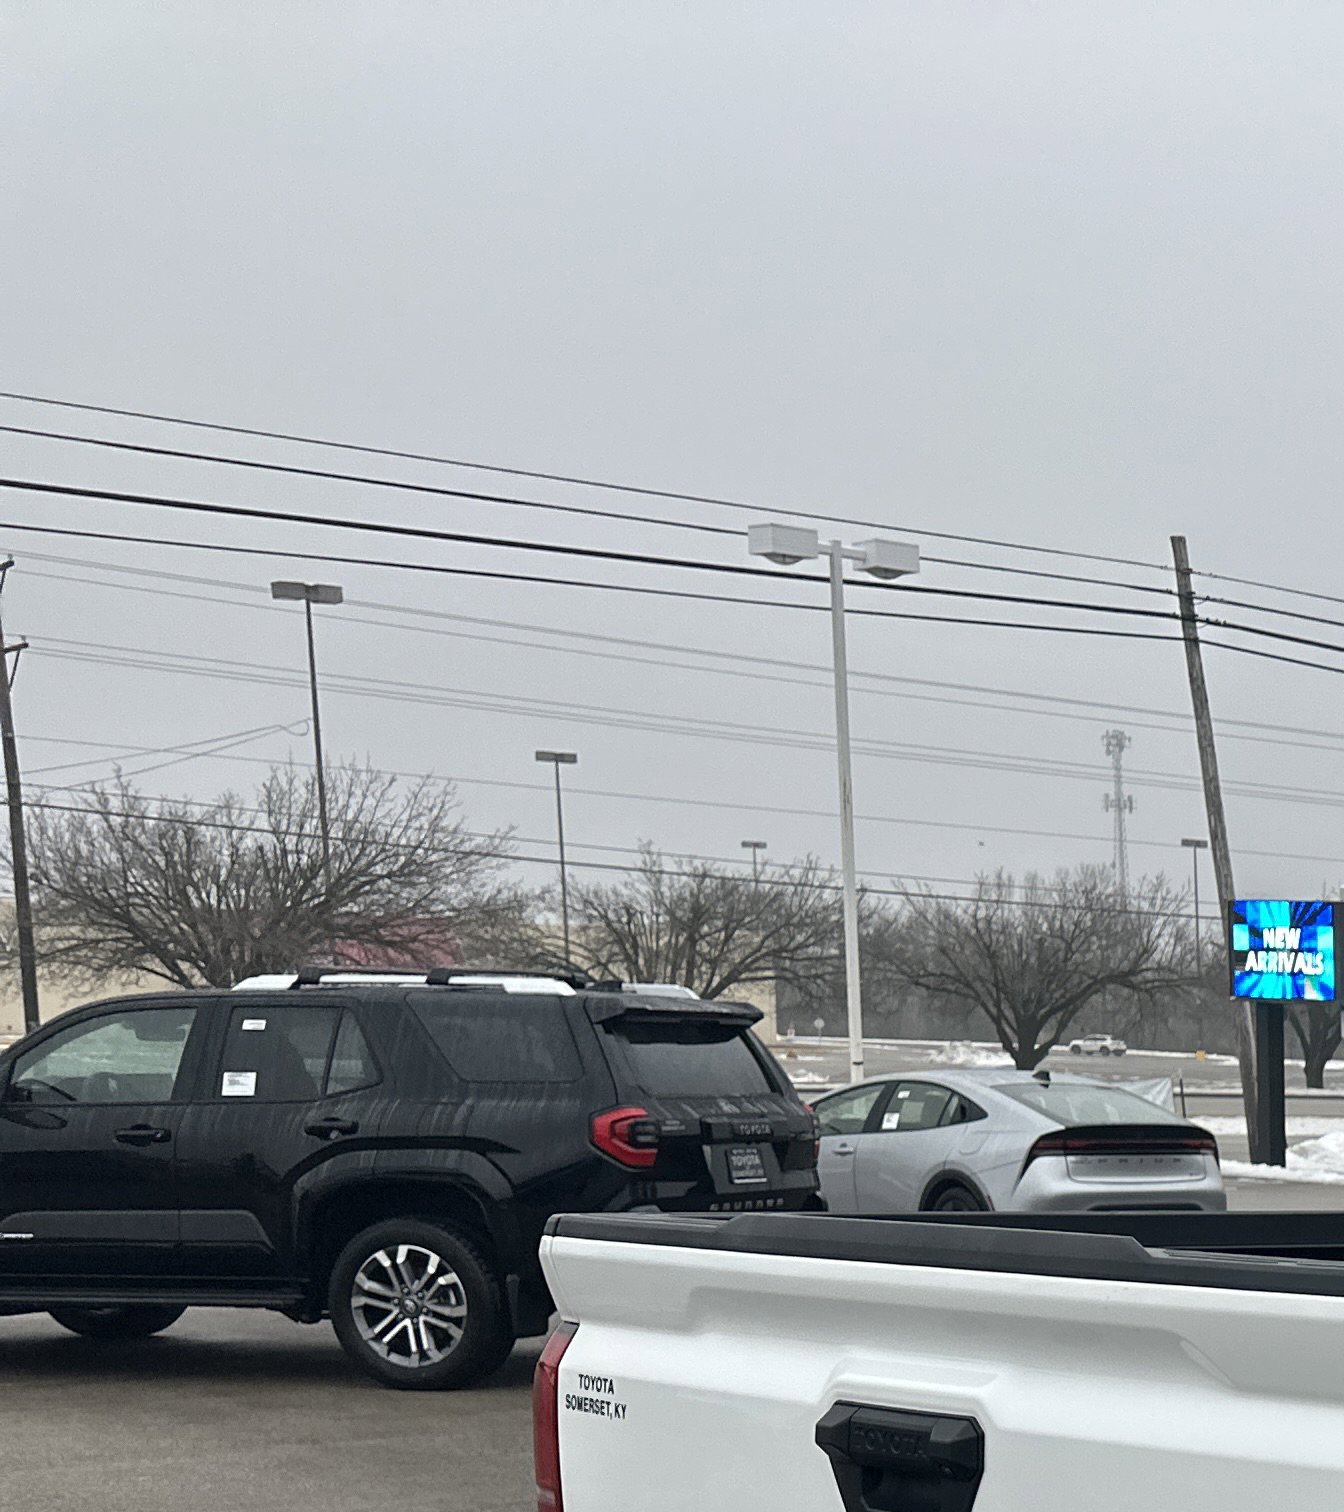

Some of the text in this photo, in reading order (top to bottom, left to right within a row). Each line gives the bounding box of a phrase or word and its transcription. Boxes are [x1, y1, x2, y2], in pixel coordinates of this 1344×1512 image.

[1262, 926, 1301, 950] NEW
[1244, 950, 1325, 976] ARRIVALS
[578, 1373, 615, 1395] TOYOTA
[565, 1393, 627, 1420] SOMERSET, KY
[852, 1425, 928, 1459] TOYOTA
